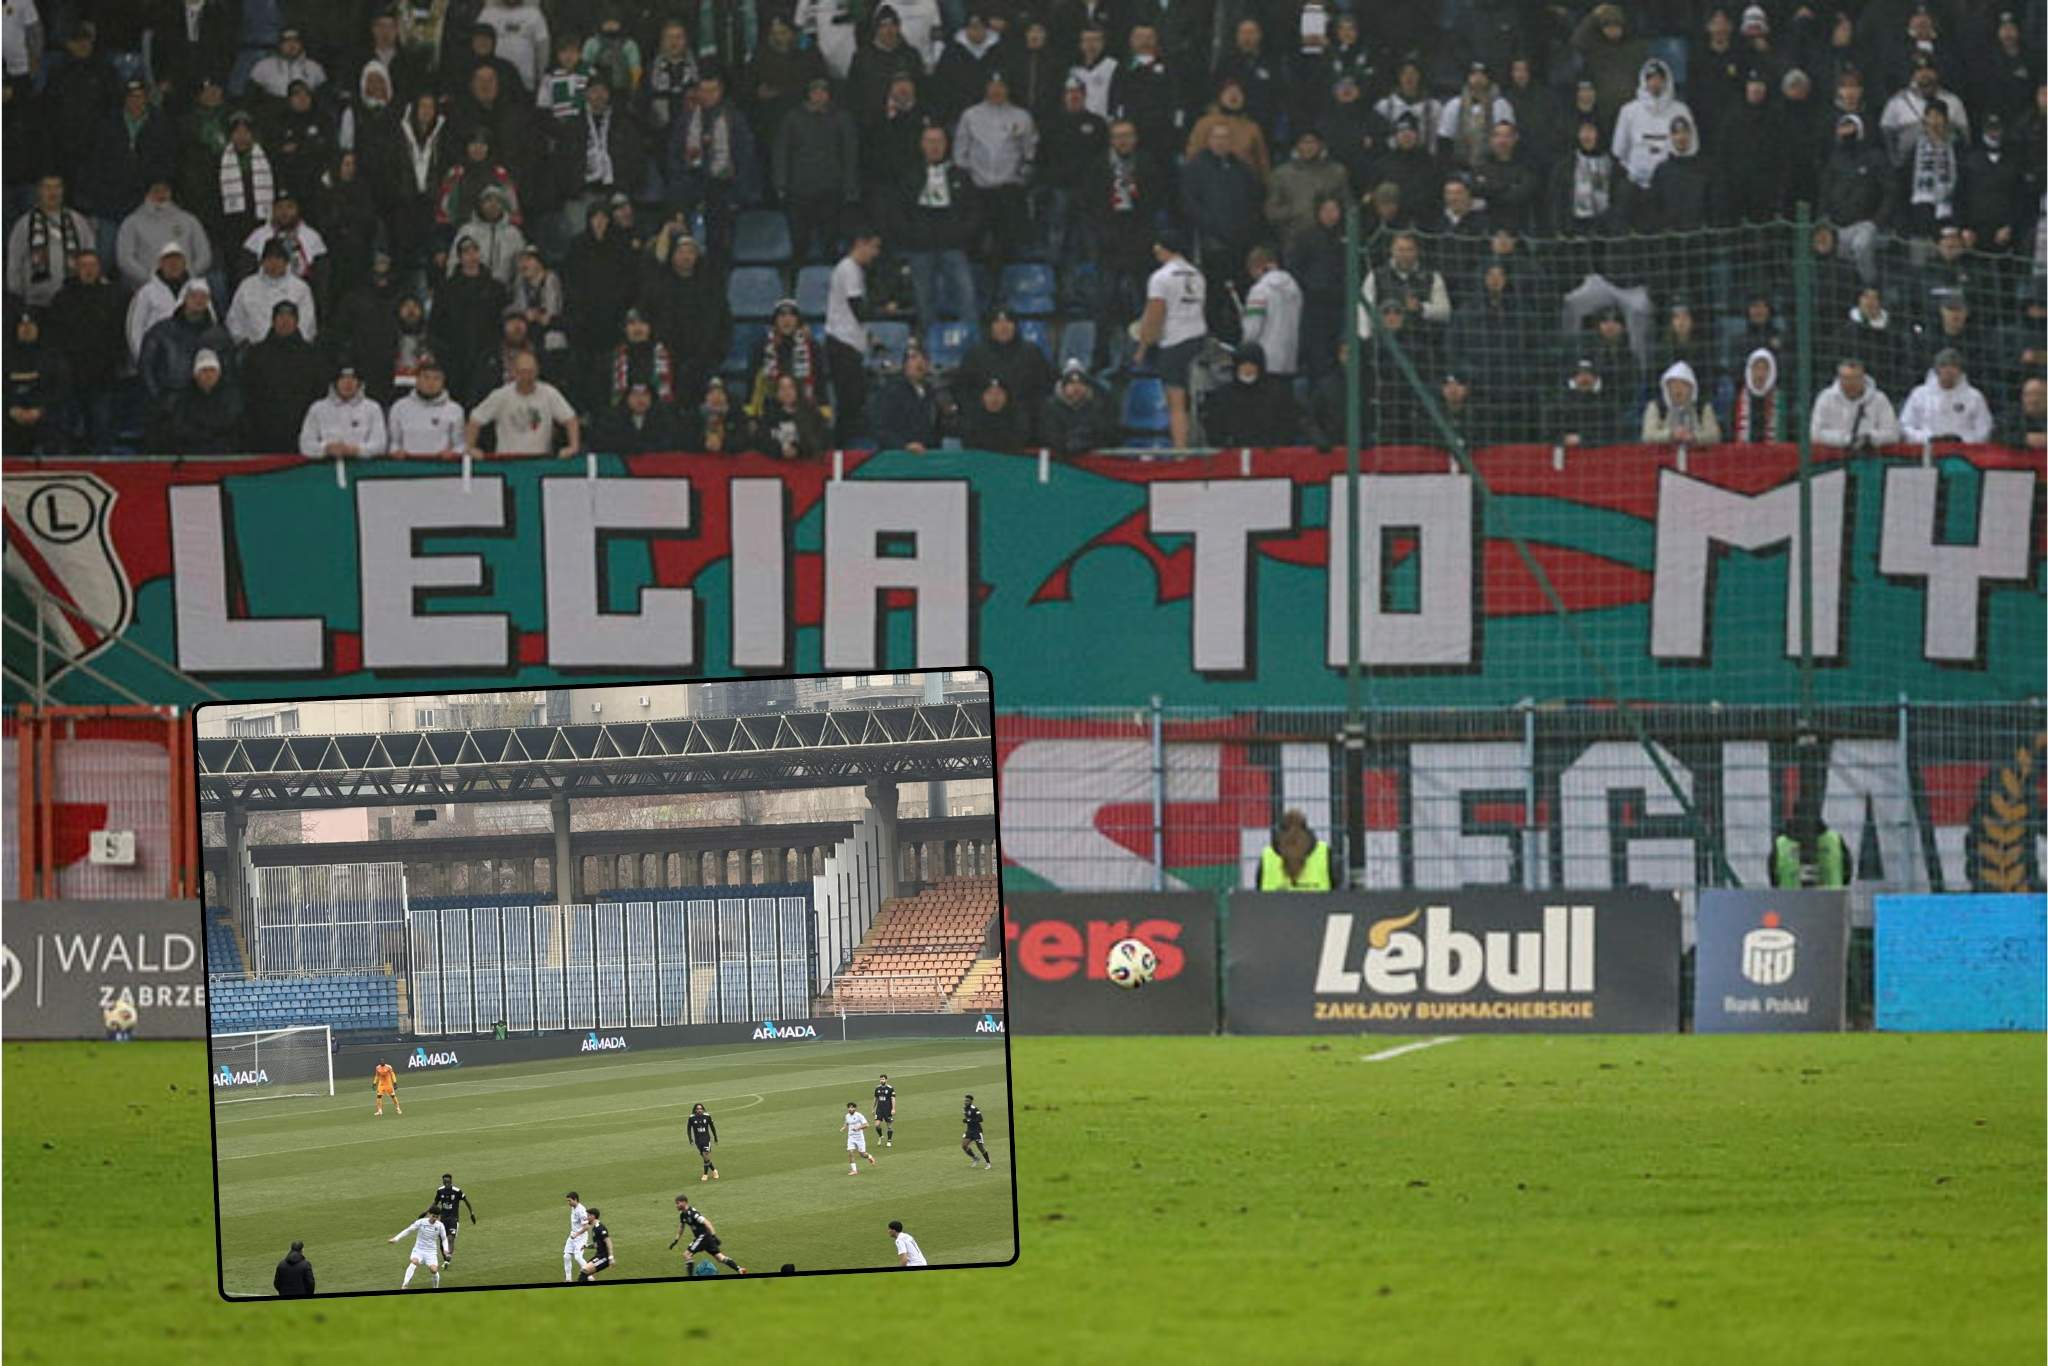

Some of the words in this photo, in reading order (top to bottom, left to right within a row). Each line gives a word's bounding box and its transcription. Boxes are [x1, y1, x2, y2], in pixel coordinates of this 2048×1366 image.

[48, 494, 78, 532] L
[168, 476, 970, 672] LEGIA
[1148, 474, 1474, 670] TO
[1651, 466, 2036, 661] MY
[54, 933, 204, 973] WALD
[100, 984, 205, 1007] ZABRZE
[1724, 996, 1760, 1012] Bank
[1765, 996, 1809, 1013] Polski
[1314, 1002, 1412, 1019] ZAKŁADY
[1416, 1002, 1594, 1019] BUKMACHERSKIE
[752, 1024, 817, 1040] ARMADA
[975, 1020, 1005, 1033] ARM
[581, 1035, 627, 1051] ARMADA
[408, 1050, 458, 1068] ARMADA
[213, 1069, 269, 1087] ARMADA
